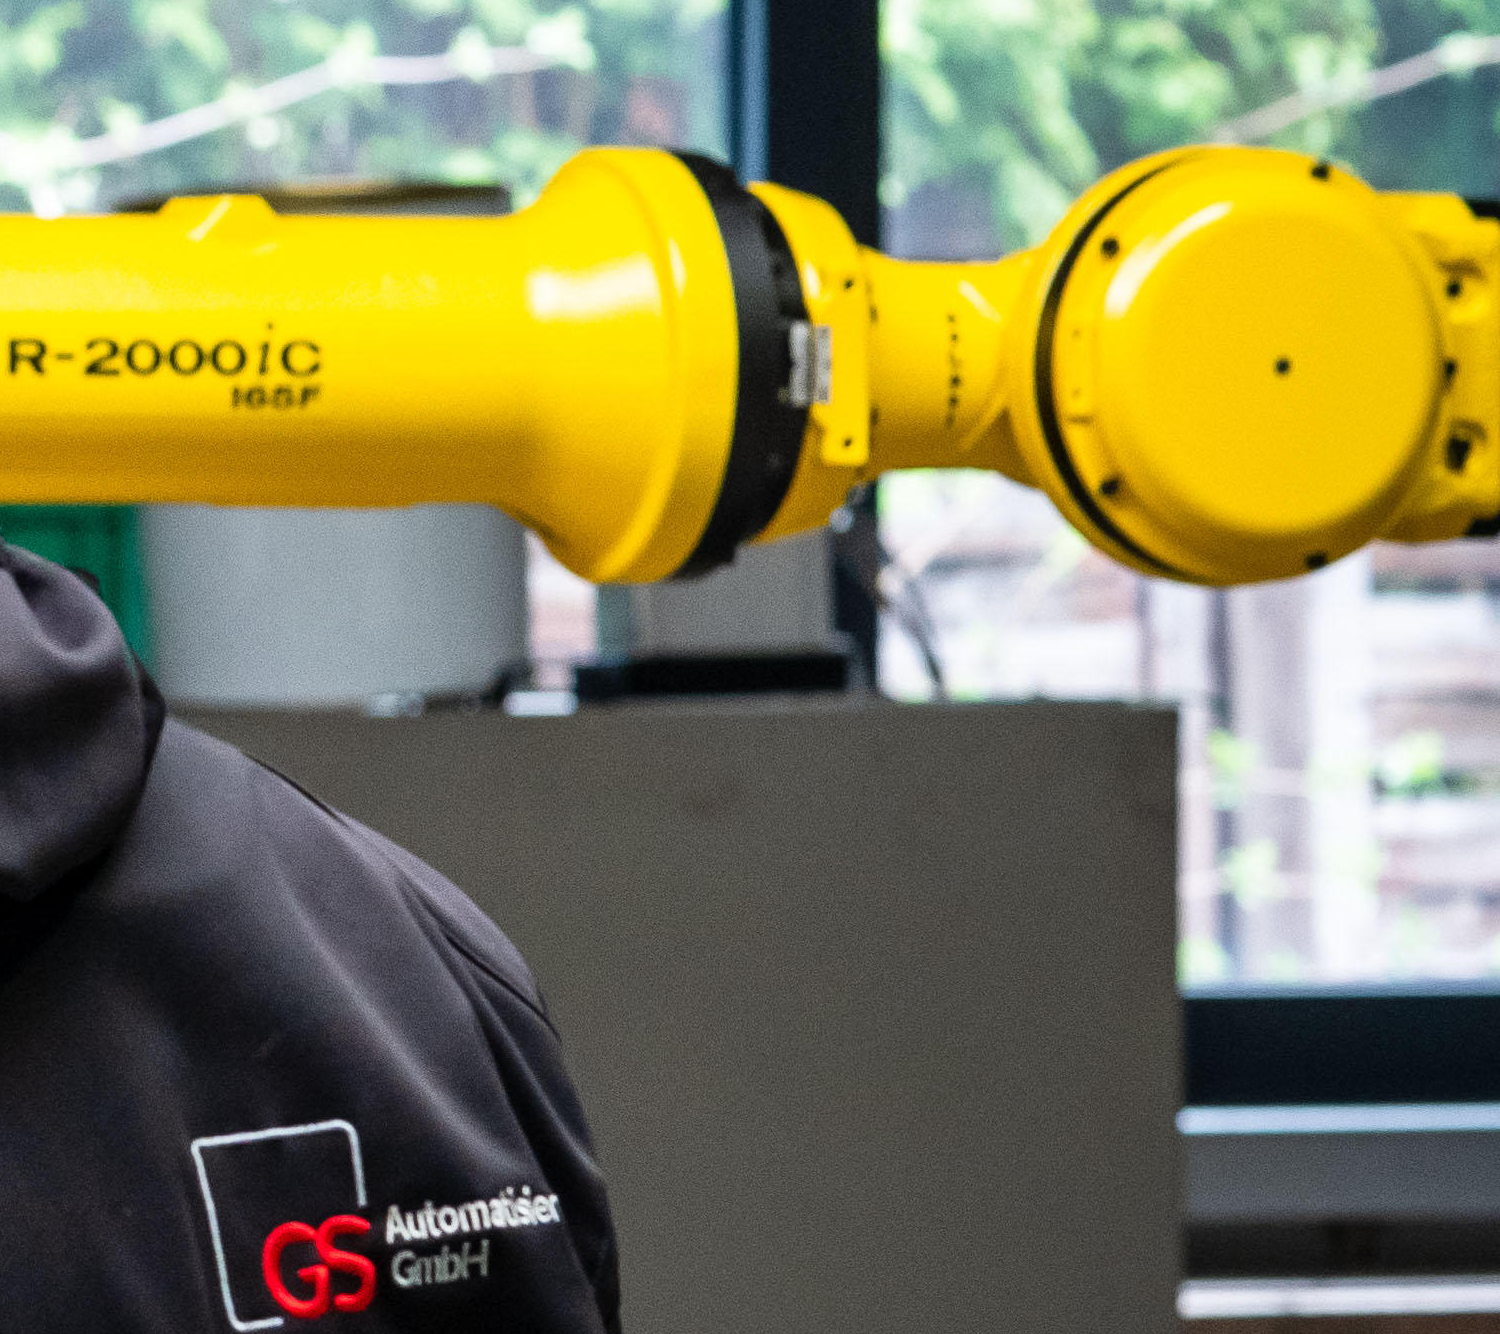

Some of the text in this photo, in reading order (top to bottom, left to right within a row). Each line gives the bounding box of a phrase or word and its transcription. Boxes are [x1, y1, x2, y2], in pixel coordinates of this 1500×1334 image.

[8, 320, 321, 376] R-2000iC
[262, 1214, 376, 1320] GS
[390, 1238, 490, 1288] GmbH
